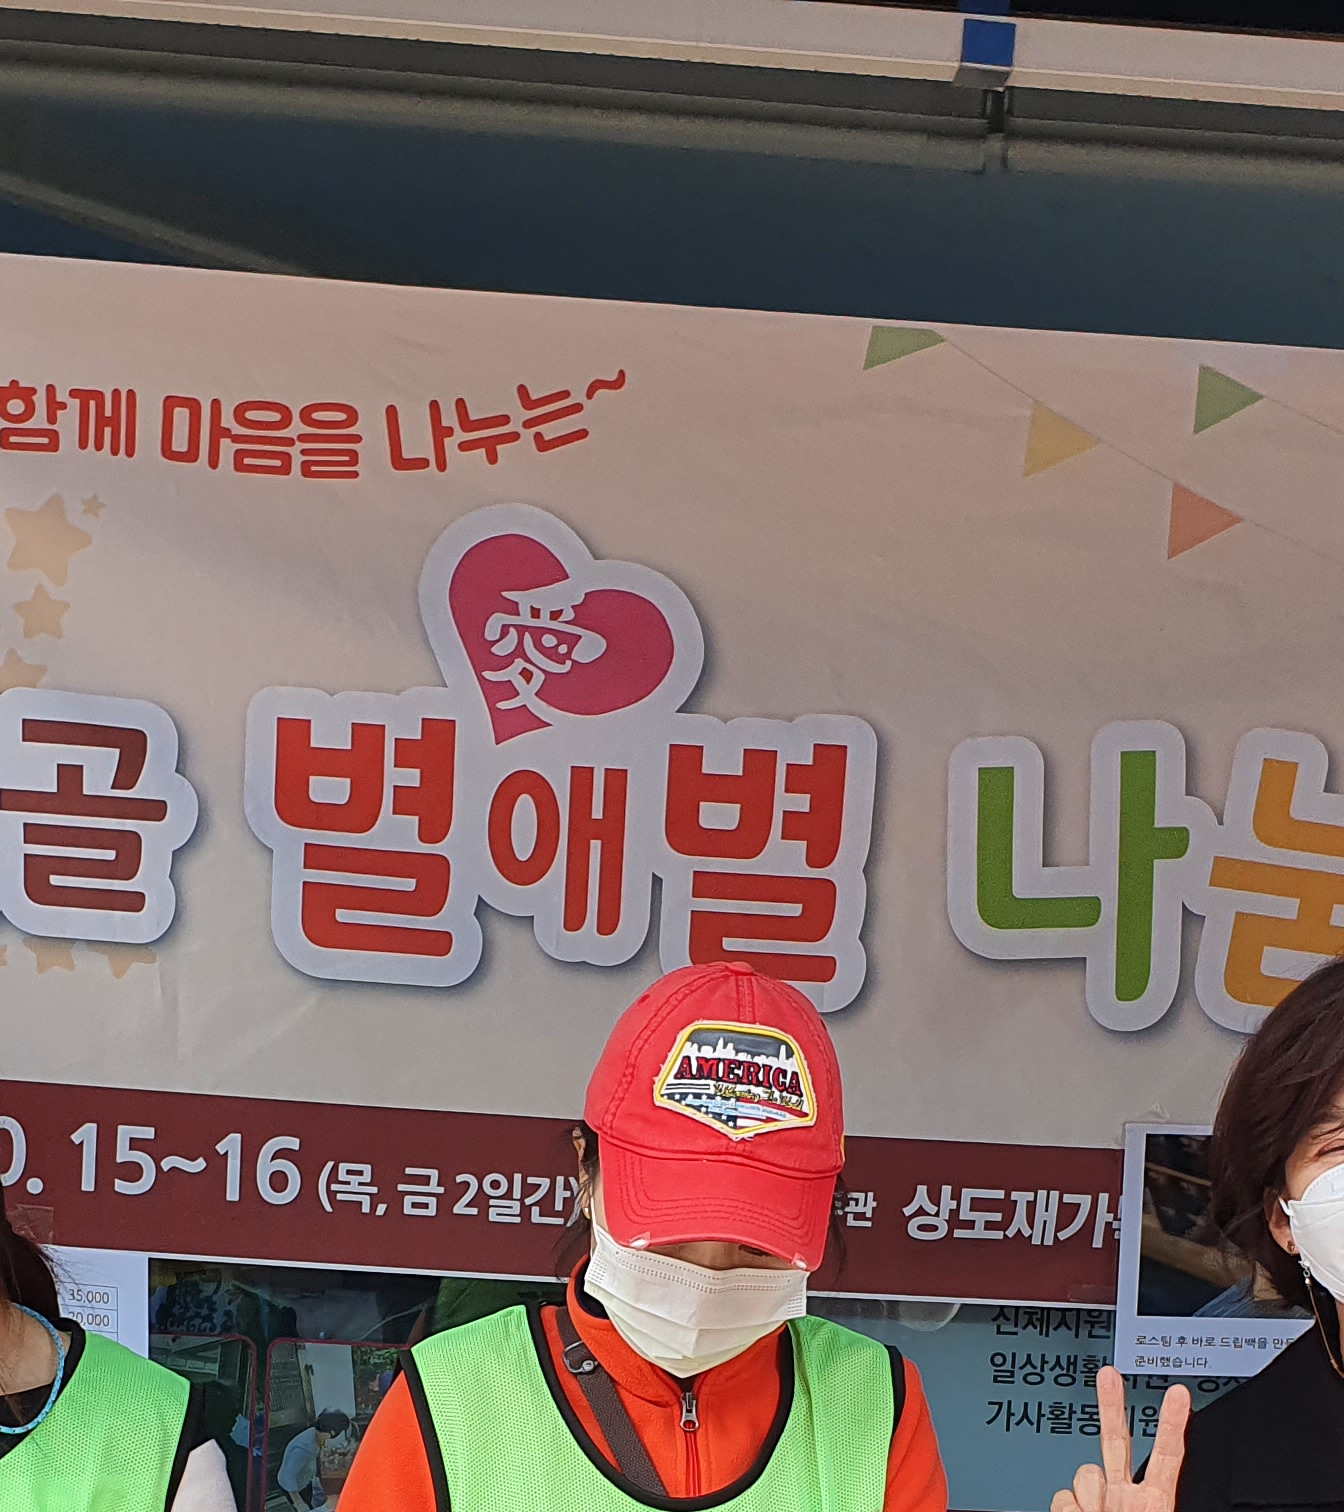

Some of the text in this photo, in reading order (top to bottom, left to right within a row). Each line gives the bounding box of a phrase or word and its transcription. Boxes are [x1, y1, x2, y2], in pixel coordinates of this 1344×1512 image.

[160, 396, 364, 480] 마음을
[482, 589, 606, 713] 愛
[274, 716, 848, 984] 별애별
[674, 1056, 803, 1096] AMERICA
[70, 1122, 302, 1205] 15~16
[318, 1160, 387, 1217] (목,
[397, 1168, 444, 1217] 금
[902, 1184, 1124, 1248] 상도재가
[68, 1289, 109, 1304] 35,000
[1176, 1336, 1188, 1347] 후
[1192, 1336, 1215, 1347] 바로
